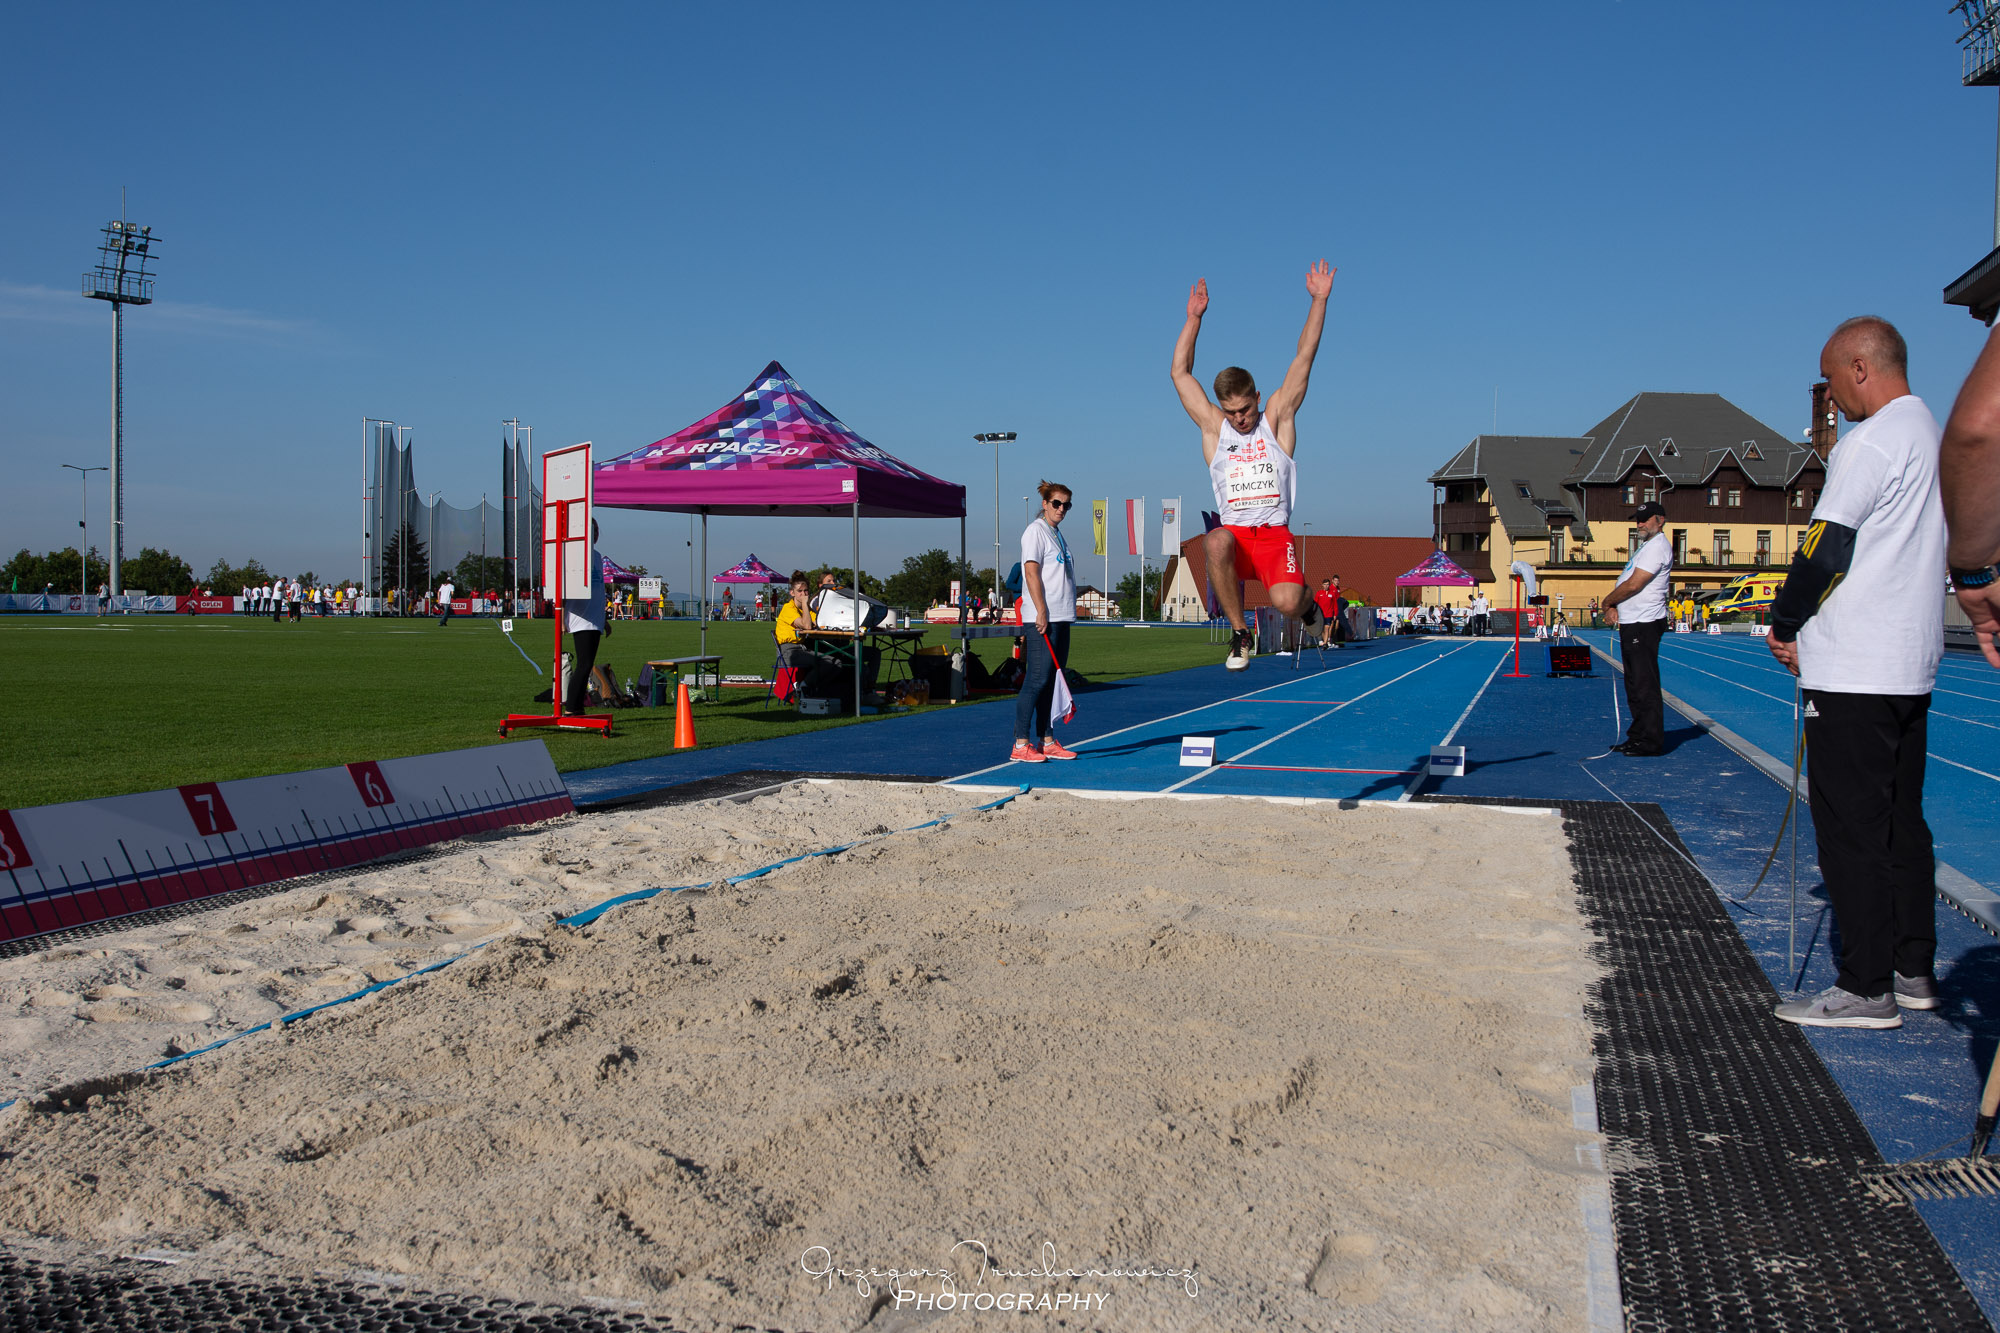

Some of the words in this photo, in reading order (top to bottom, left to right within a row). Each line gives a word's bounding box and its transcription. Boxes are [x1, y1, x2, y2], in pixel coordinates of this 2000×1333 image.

[646, 441, 809, 458] KARPACZ.pl
[1229, 452, 1267, 462] POLSKA
[1252, 463, 1274, 475] 178
[1230, 480, 1275, 493] TOMCZYK
[365, 771, 385, 803] 6
[193, 793, 218, 832] 7
